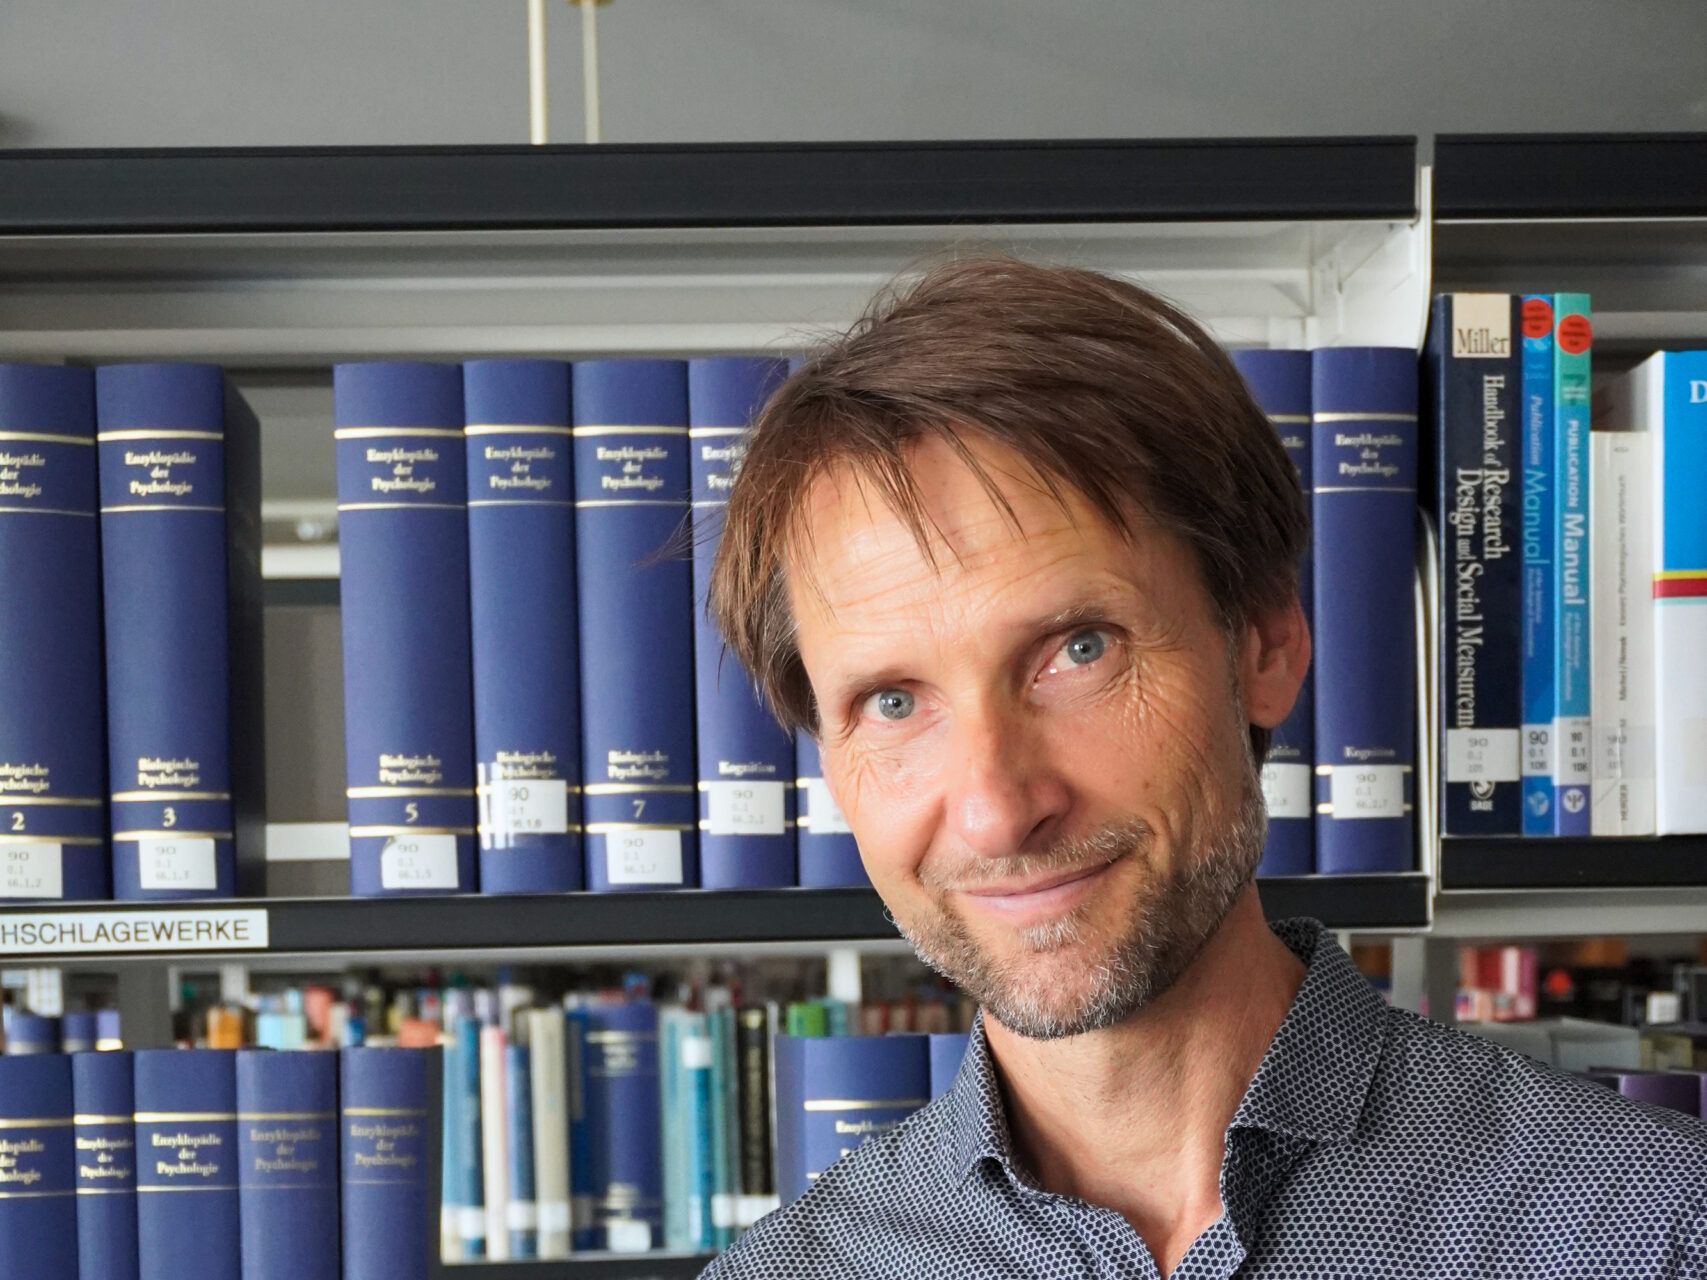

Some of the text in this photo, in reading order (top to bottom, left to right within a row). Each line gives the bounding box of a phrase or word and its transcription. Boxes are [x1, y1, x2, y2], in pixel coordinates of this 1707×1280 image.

[1457, 329, 1508, 354] Miller
[1529, 395, 1544, 465] Publication
[125, 452, 196, 467] Enzyklopädie
[1483, 375, 1510, 559] Handbook of Research
[151, 467, 169, 478] der
[394, 463, 413, 475] der
[130, 481, 192, 496] Psychologie
[372, 477, 435, 492] Psychologie
[1525, 469, 1550, 564] Manual
[1563, 419, 1585, 604] PUBLICATION Manual
[1449, 468, 1484, 728] Design and Social Measurem
[1530, 731, 1548, 744] 90
[138, 758, 199, 773] Biologische
[718, 761, 776, 776] Kognition
[138, 773, 199, 788] Psychologie
[405, 803, 418, 822] 5
[632, 800, 646, 818] 7
[1471, 800, 1494, 811] SAGE
[12, 812, 24, 830] 2
[163, 808, 176, 826] 3
[1, 919, 249, 945] HSCHLAGEWERKE
[152, 1133, 221, 1148] Enzyklopädie
[178, 1148, 196, 1160] der
[157, 1161, 219, 1176] Psychologie
